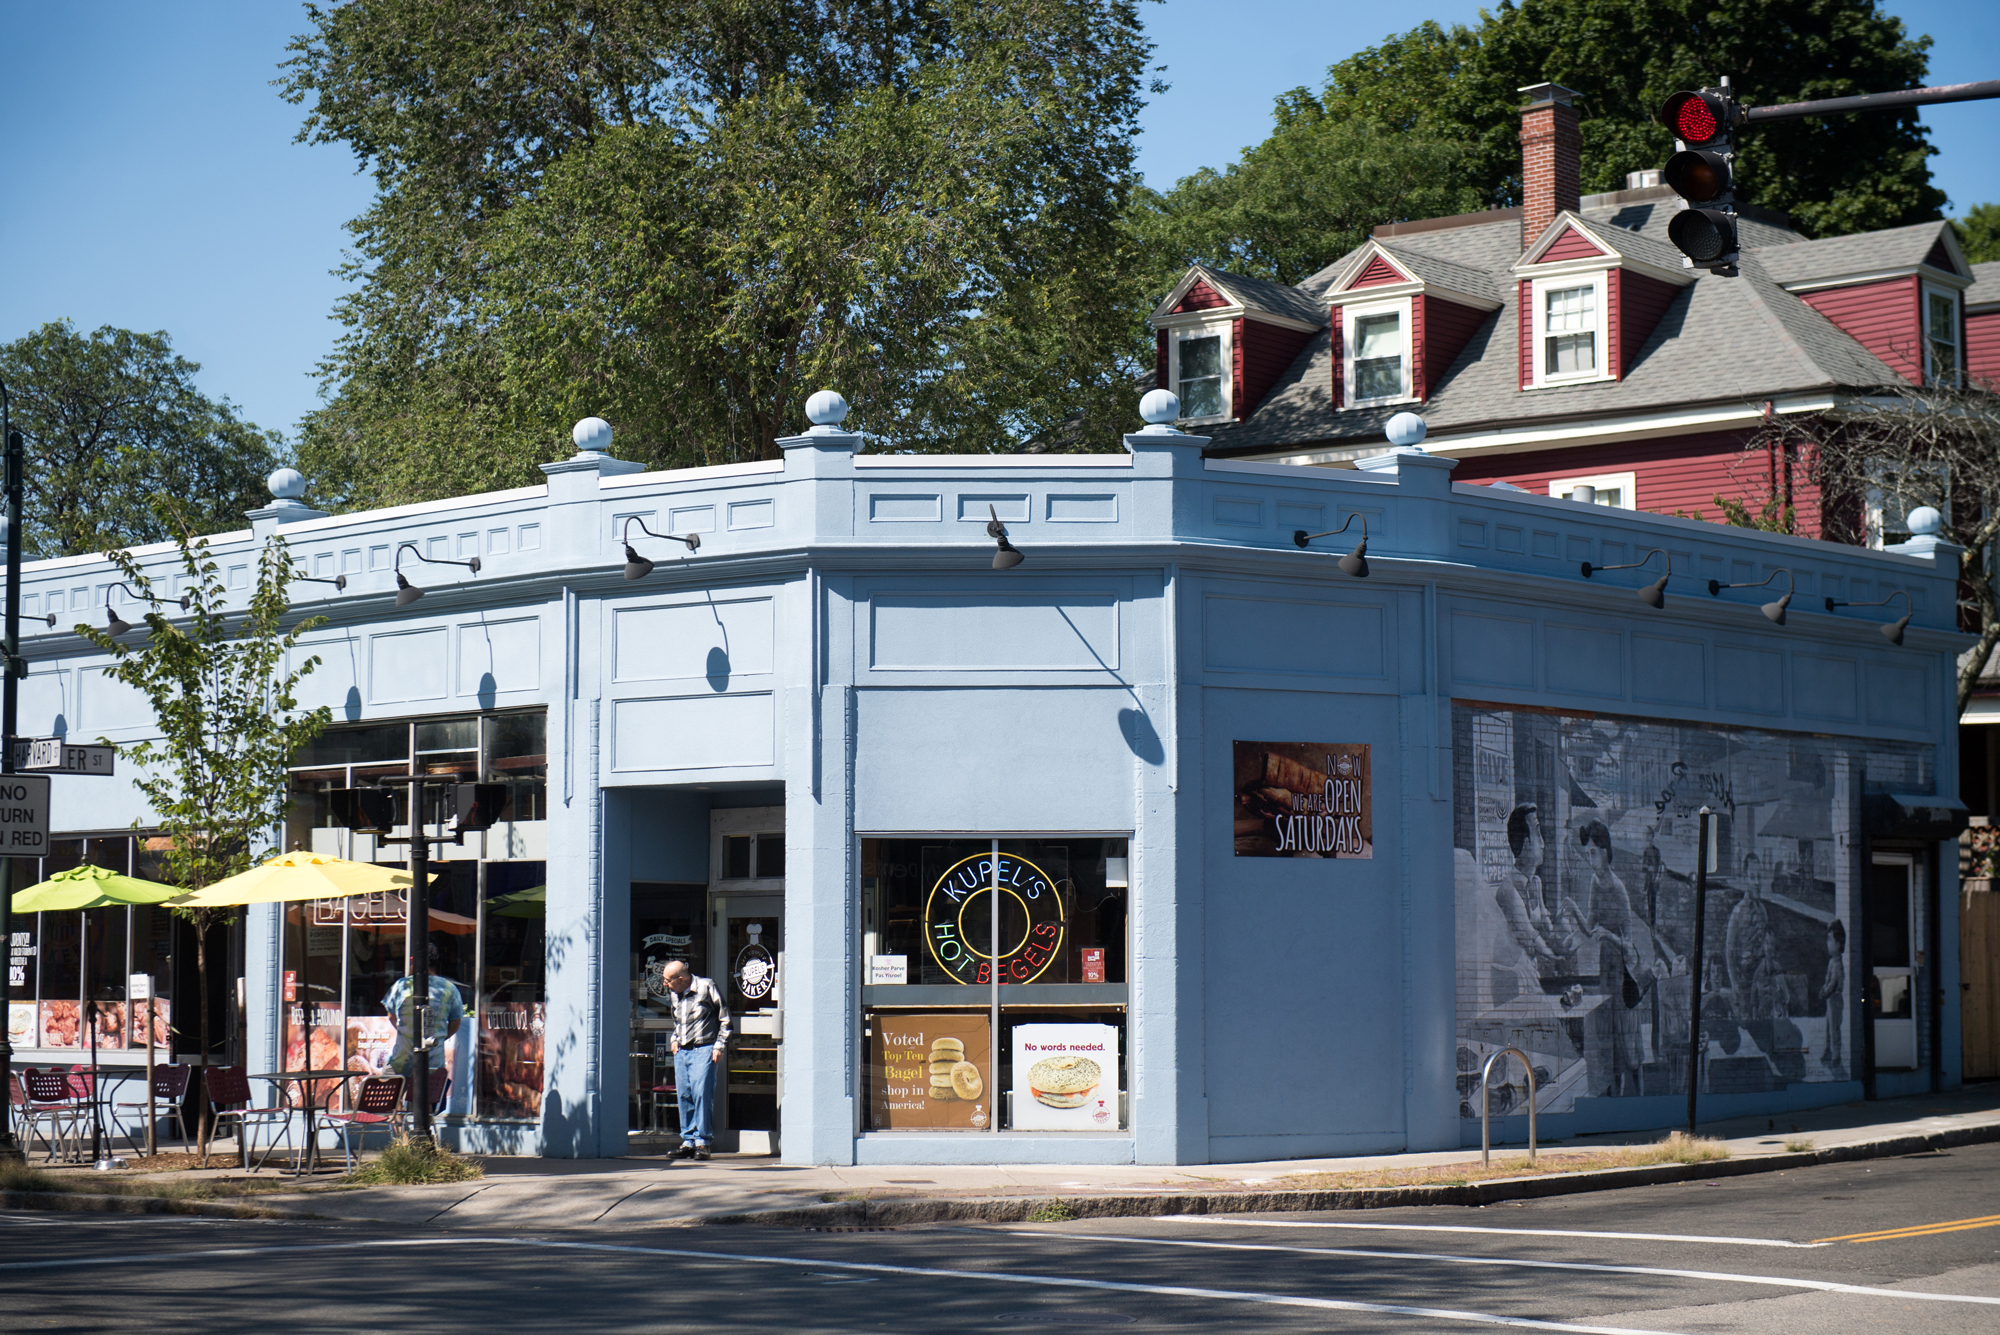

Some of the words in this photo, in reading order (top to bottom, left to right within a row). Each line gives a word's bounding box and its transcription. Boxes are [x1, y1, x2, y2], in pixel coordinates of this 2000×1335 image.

[15, 742, 52, 767] HARVARD
[54, 746, 60, 758] ST
[93, 755, 102, 766] ST
[1478, 751, 1509, 786] GIVE
[0, 785, 26, 800] NO
[1292, 793, 1304, 812] WE
[1307, 794, 1322, 812] ARE
[1324, 778, 1362, 814] OPEN
[0, 808, 34, 823] URN
[1479, 815, 1497, 824] SECURITY
[12, 831, 42, 846] RED
[1275, 814, 1363, 853] SATURDAYS
[1481, 831, 1509, 847] COMBINE
[942, 860, 1046, 903] KUPEL'S
[666, 936, 686, 944] SPECIALS
[934, 923, 976, 972] HOT
[9, 966, 25, 980] 10%
[742, 962, 766, 978] KUPEL'S
[741, 974, 770, 996] BAKERY
[487, 1009, 528, 1030] DELICIOUS!
[882, 1032, 924, 1046] Voted
[1024, 1043, 1037, 1051] No
[1040, 1043, 1067, 1051] words
[1070, 1043, 1106, 1051] needed.
[882, 1051, 902, 1063] Top
[904, 1051, 924, 1060] Ten
[884, 1066, 924, 1082] Bagel
[881, 1085, 909, 1098] shop
[912, 1086, 924, 1095] in
[881, 1100, 925, 1110] America!
